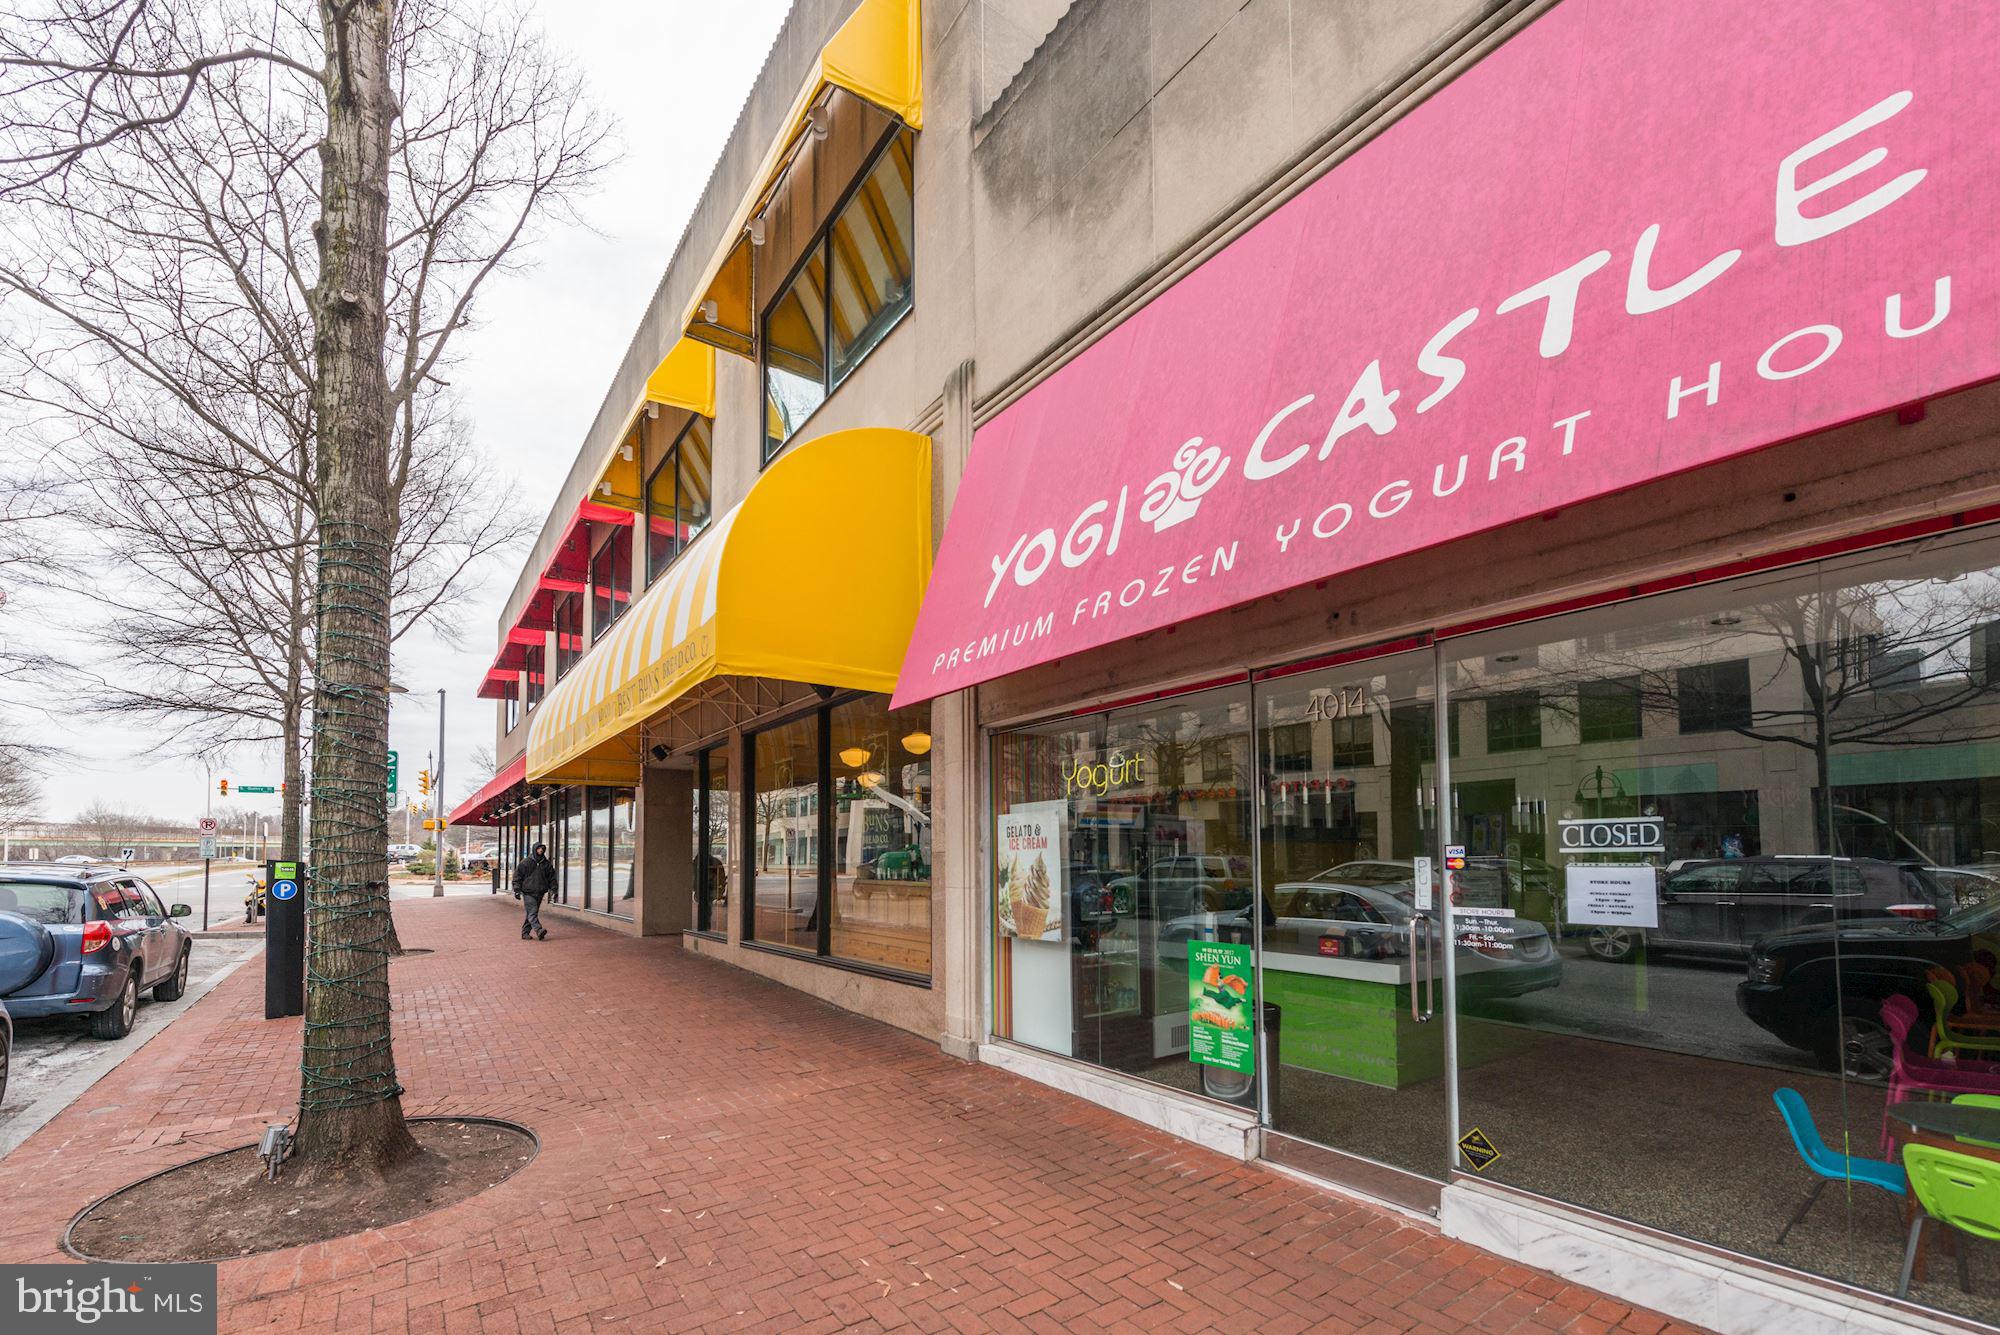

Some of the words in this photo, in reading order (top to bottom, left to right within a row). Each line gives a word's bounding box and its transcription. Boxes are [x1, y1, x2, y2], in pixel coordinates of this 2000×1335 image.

[984, 485, 1128, 608] YOGI
[1243, 90, 1928, 481] CASTLE
[932, 612, 1054, 675] PREMIUM
[1072, 541, 1238, 626] FROZEN
[1276, 411, 1591, 552] YOGURT
[1305, 687, 1366, 721] 4014
[1062, 752, 1145, 797] Yogurt
[1006, 825, 1032, 839] GELATO
[1034, 824, 1041, 836] &
[1009, 838, 1020, 850] ICE
[1022, 836, 1048, 851] CREAM
[1562, 823, 1660, 847] CLOSED
[1195, 951, 1219, 963] SHEN
[1221, 955, 1241, 966] YUN
[1461, 1142, 1495, 1157] WARNING
